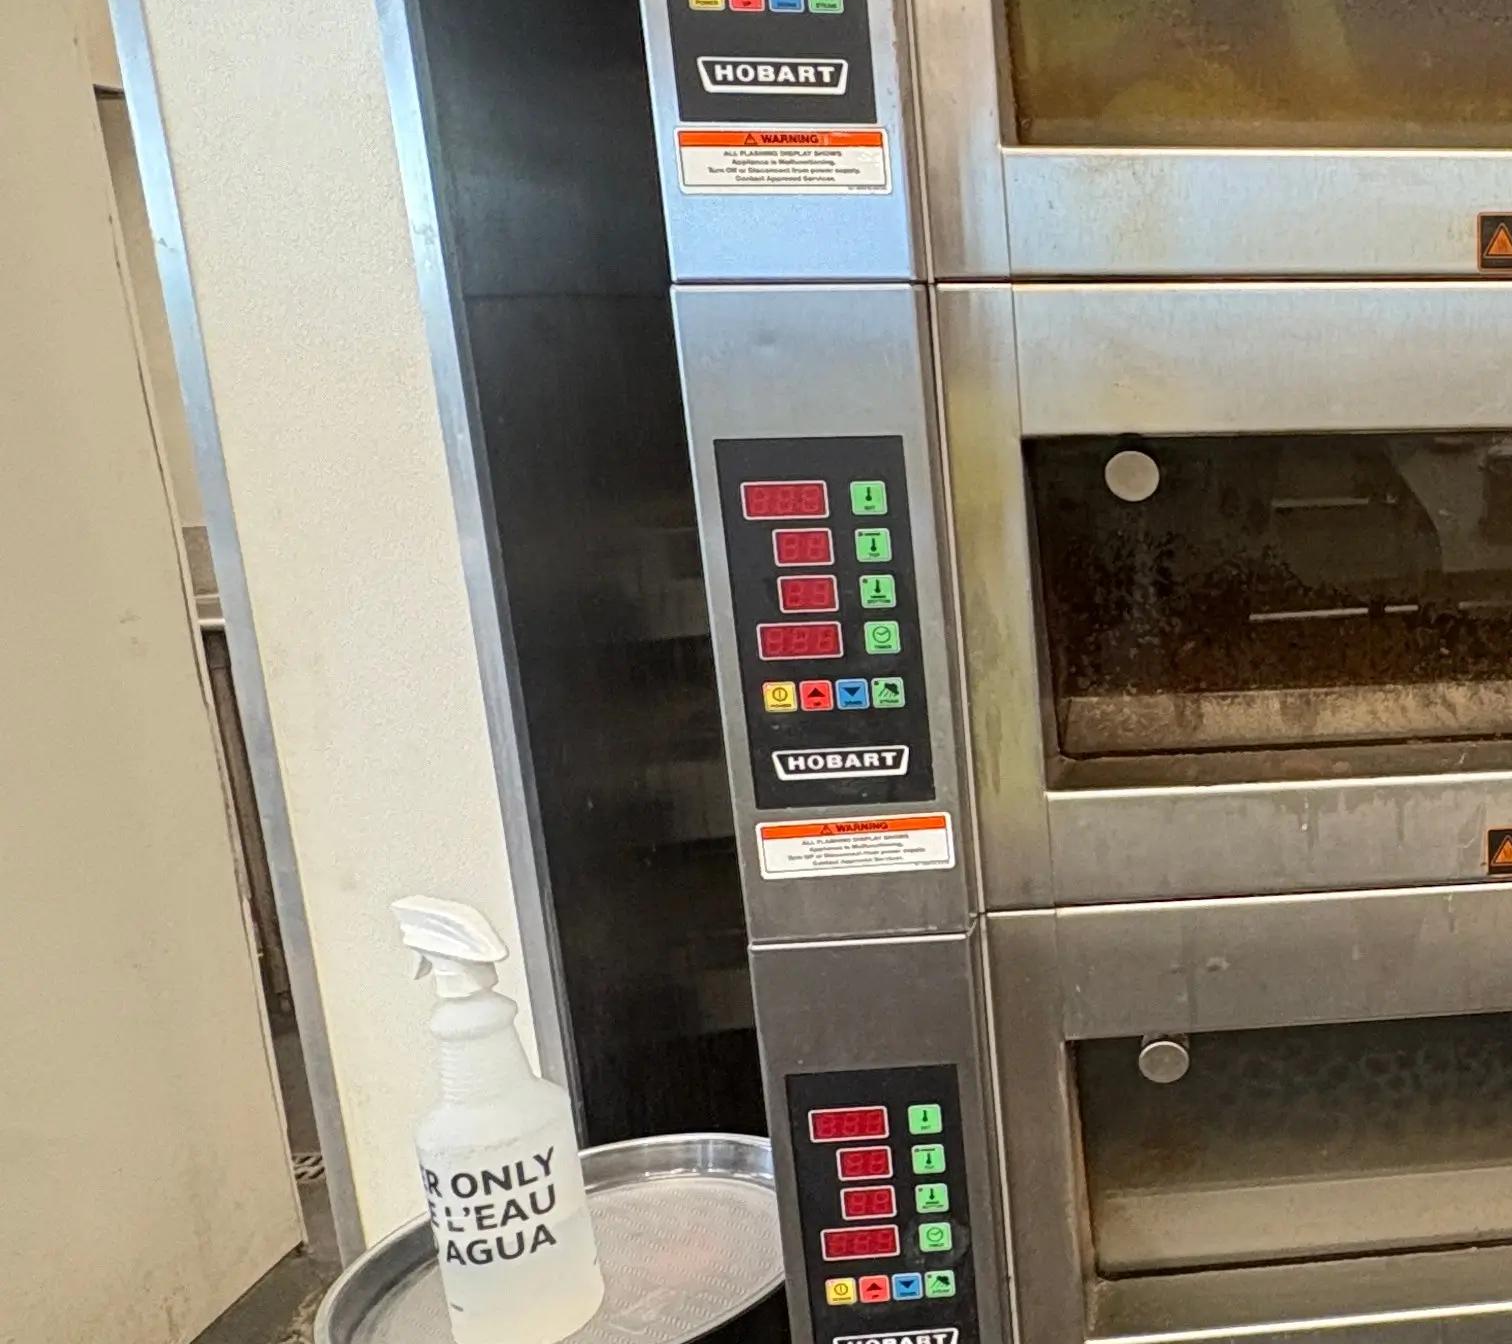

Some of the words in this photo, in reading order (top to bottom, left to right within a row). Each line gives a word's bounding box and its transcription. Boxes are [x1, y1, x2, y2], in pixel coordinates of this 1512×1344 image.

[714, 64, 836, 83] HOBART
[760, 134, 819, 144] WARNING
[788, 752, 898, 771] HOBART
[835, 822, 888, 832] WARNING
[421, 1164, 443, 1198] R
[450, 1145, 554, 1199] ONLY
[444, 1183, 556, 1233] L'EAU
[446, 1223, 557, 1266] AGUA
